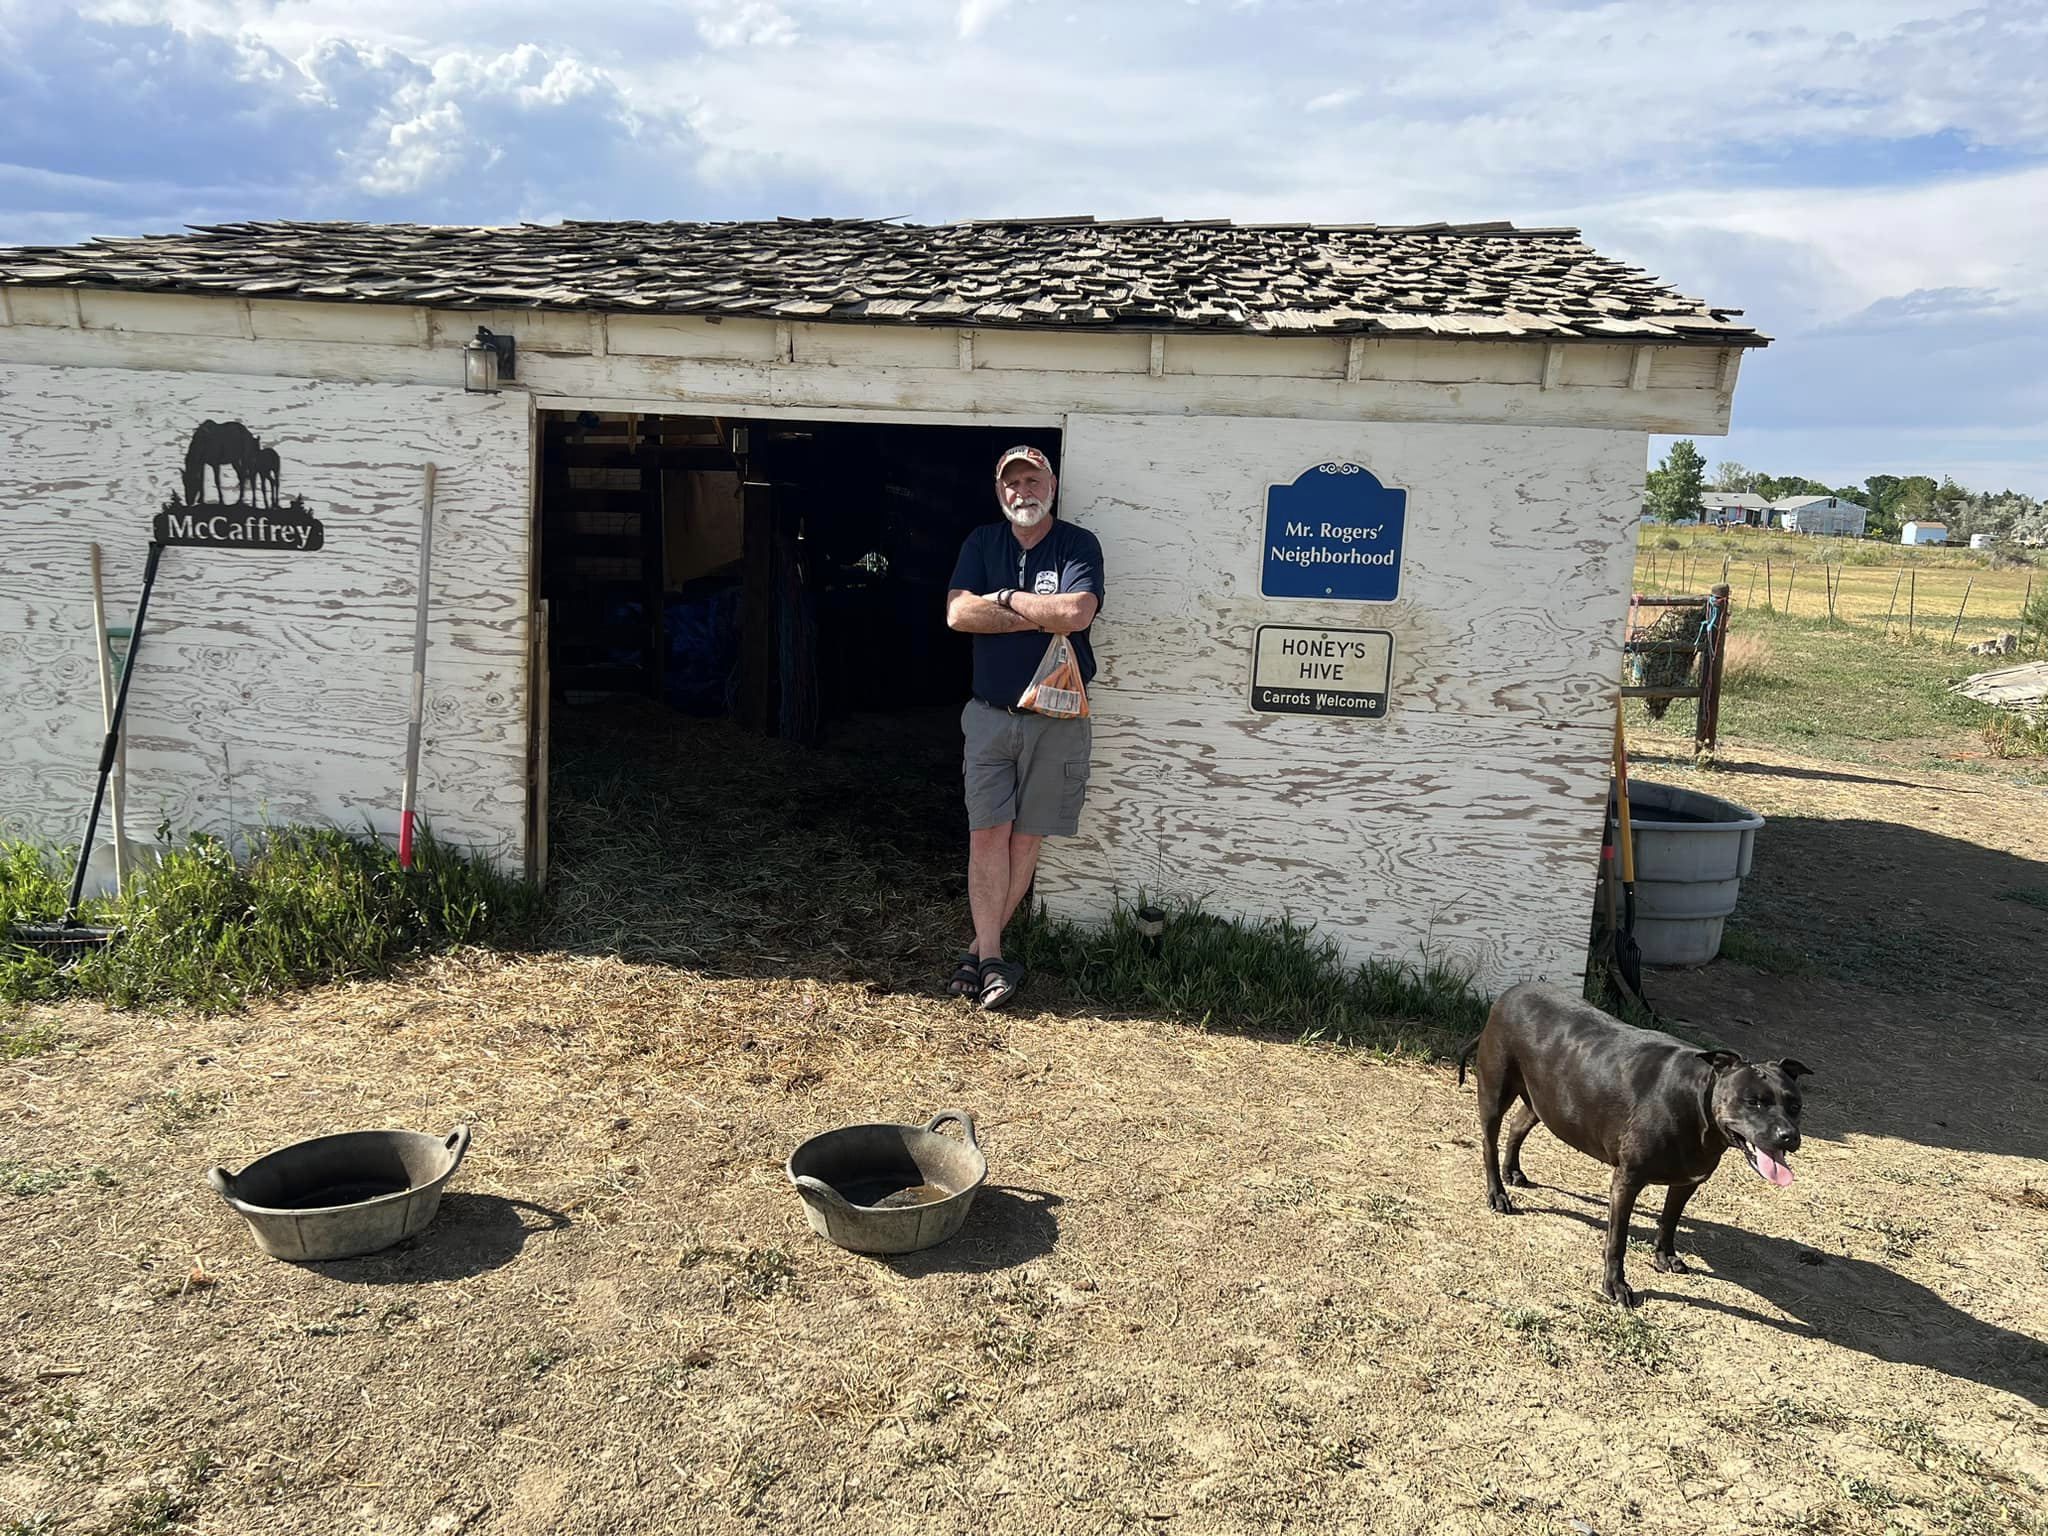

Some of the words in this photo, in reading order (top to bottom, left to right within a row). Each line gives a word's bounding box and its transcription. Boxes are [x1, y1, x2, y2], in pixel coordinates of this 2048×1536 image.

[168, 514, 312, 549] McCaffrey
[1285, 521, 1313, 538] Mr.
[1271, 546, 1395, 566] Neighborhood
[1282, 639, 1366, 658] HONEY'S
[1299, 662, 1345, 681] HIVE
[1262, 690, 1311, 706] Carrots
[1316, 693, 1377, 709] Welcome
